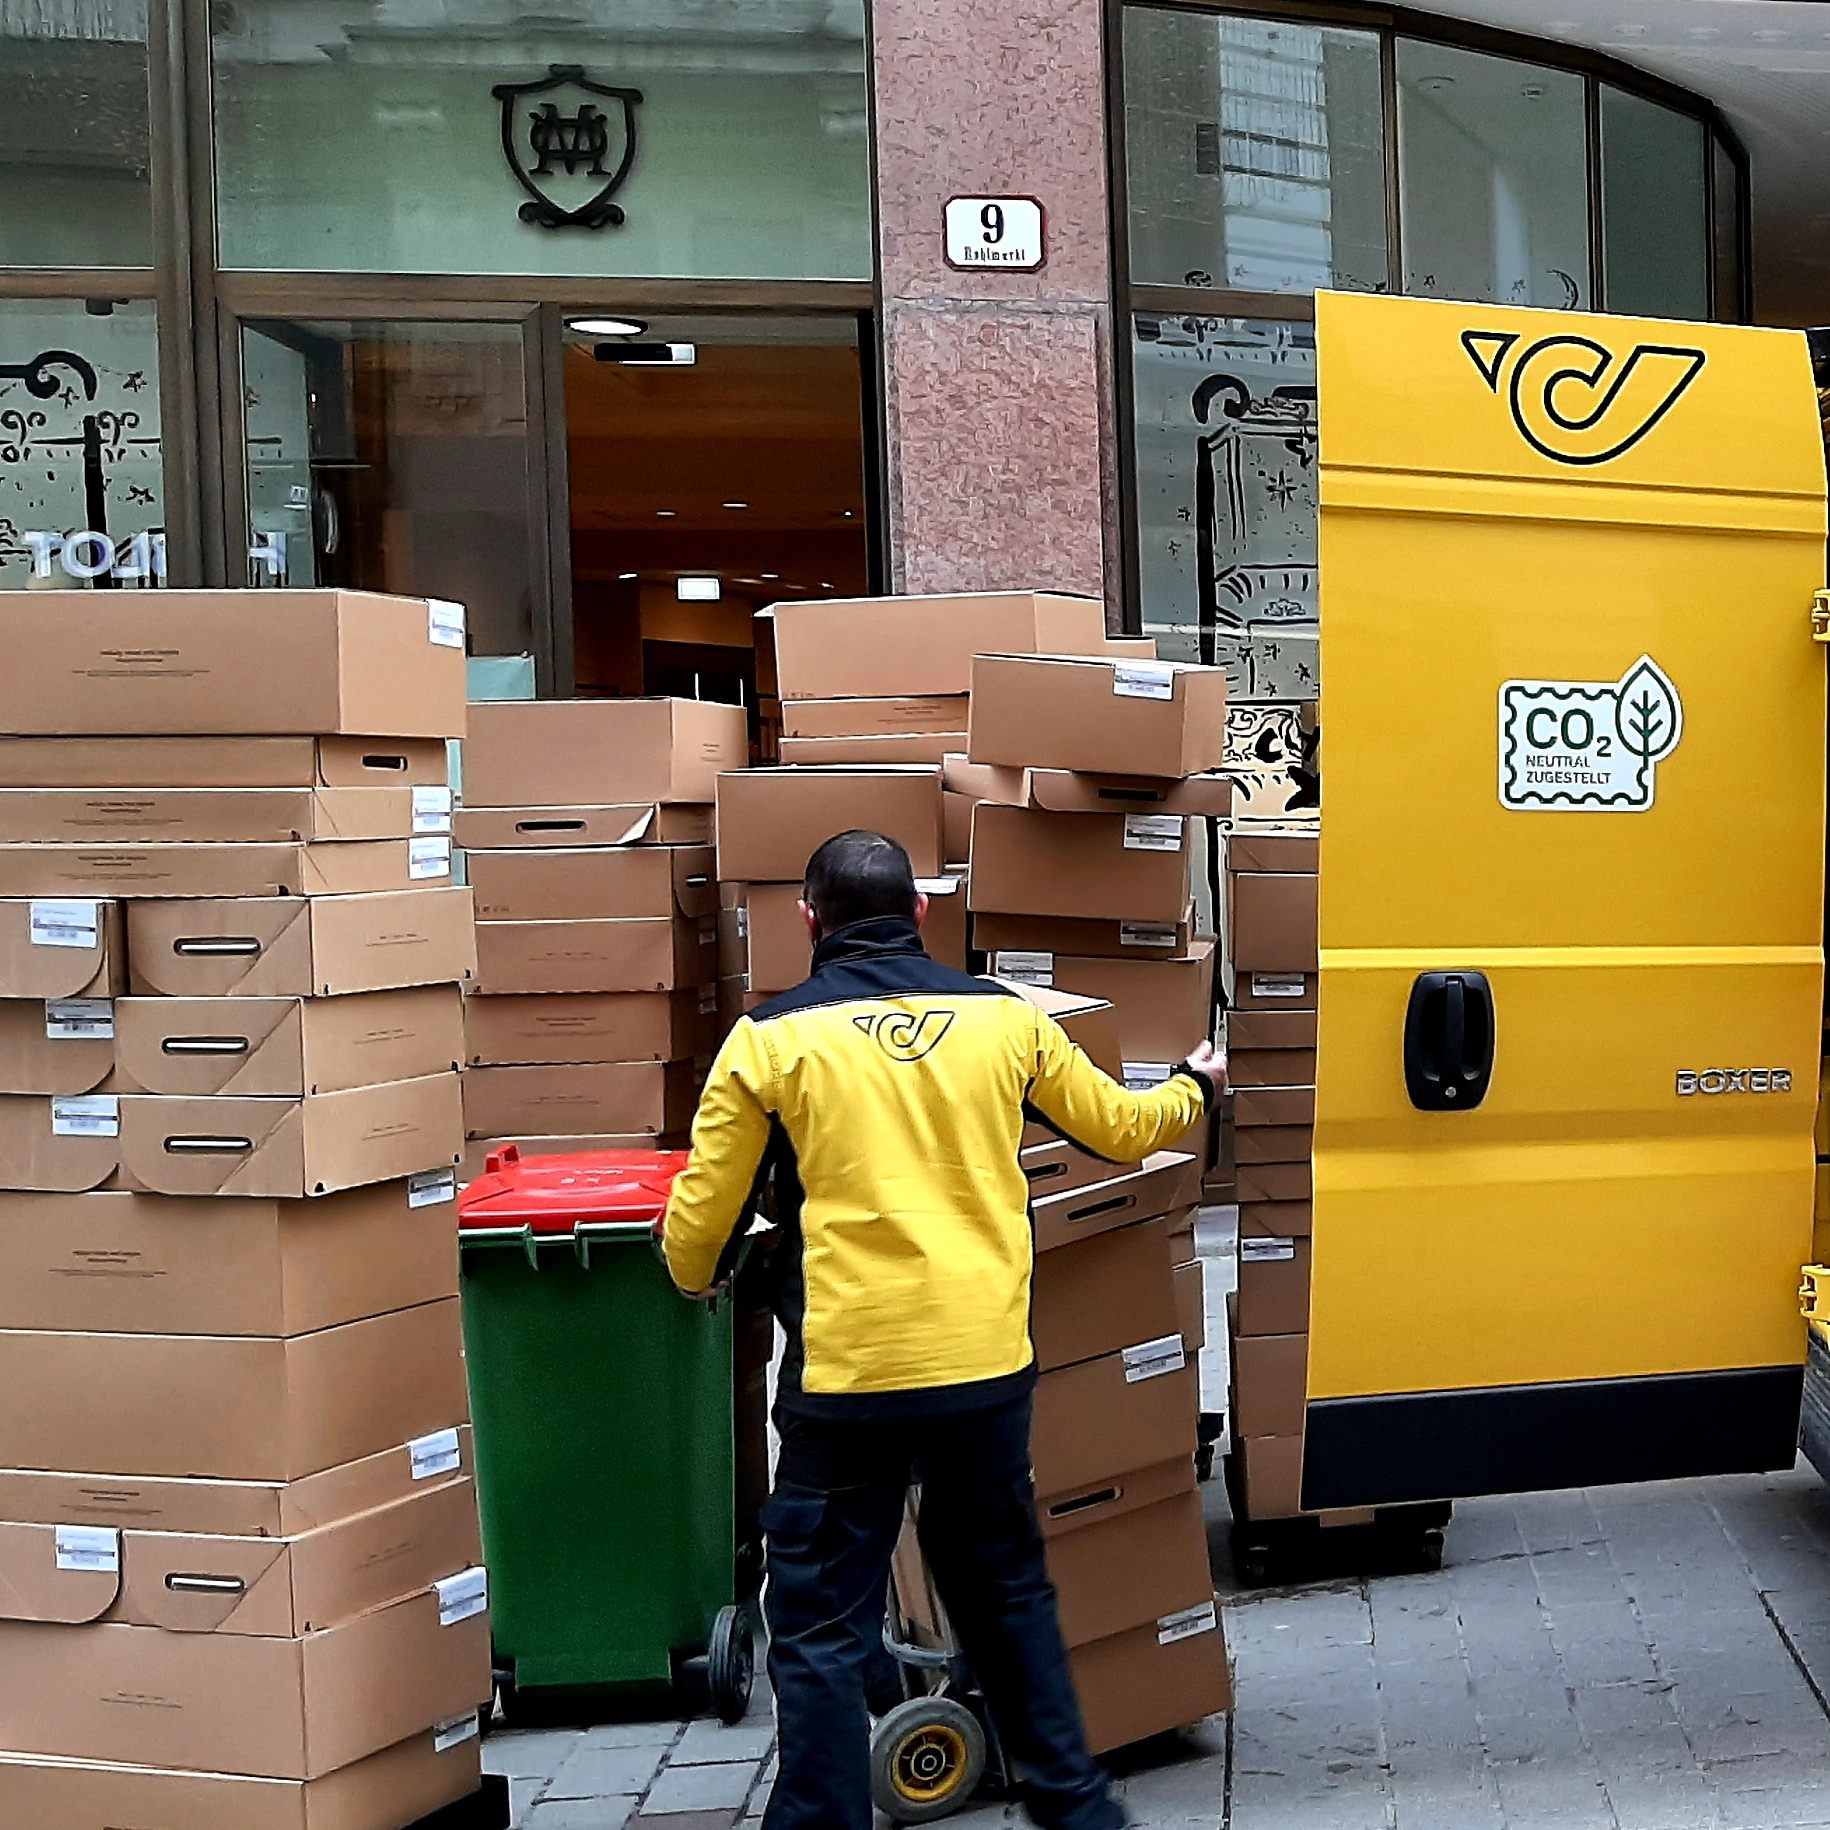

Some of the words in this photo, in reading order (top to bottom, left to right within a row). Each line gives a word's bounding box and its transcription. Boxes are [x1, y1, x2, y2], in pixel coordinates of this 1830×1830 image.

[980, 203, 1004, 244] 9
[1526, 755, 1591, 768] NEUTRAL
[1526, 771, 1612, 785] ZUGESTELLT
[1676, 1067, 1792, 1095] BOXER
